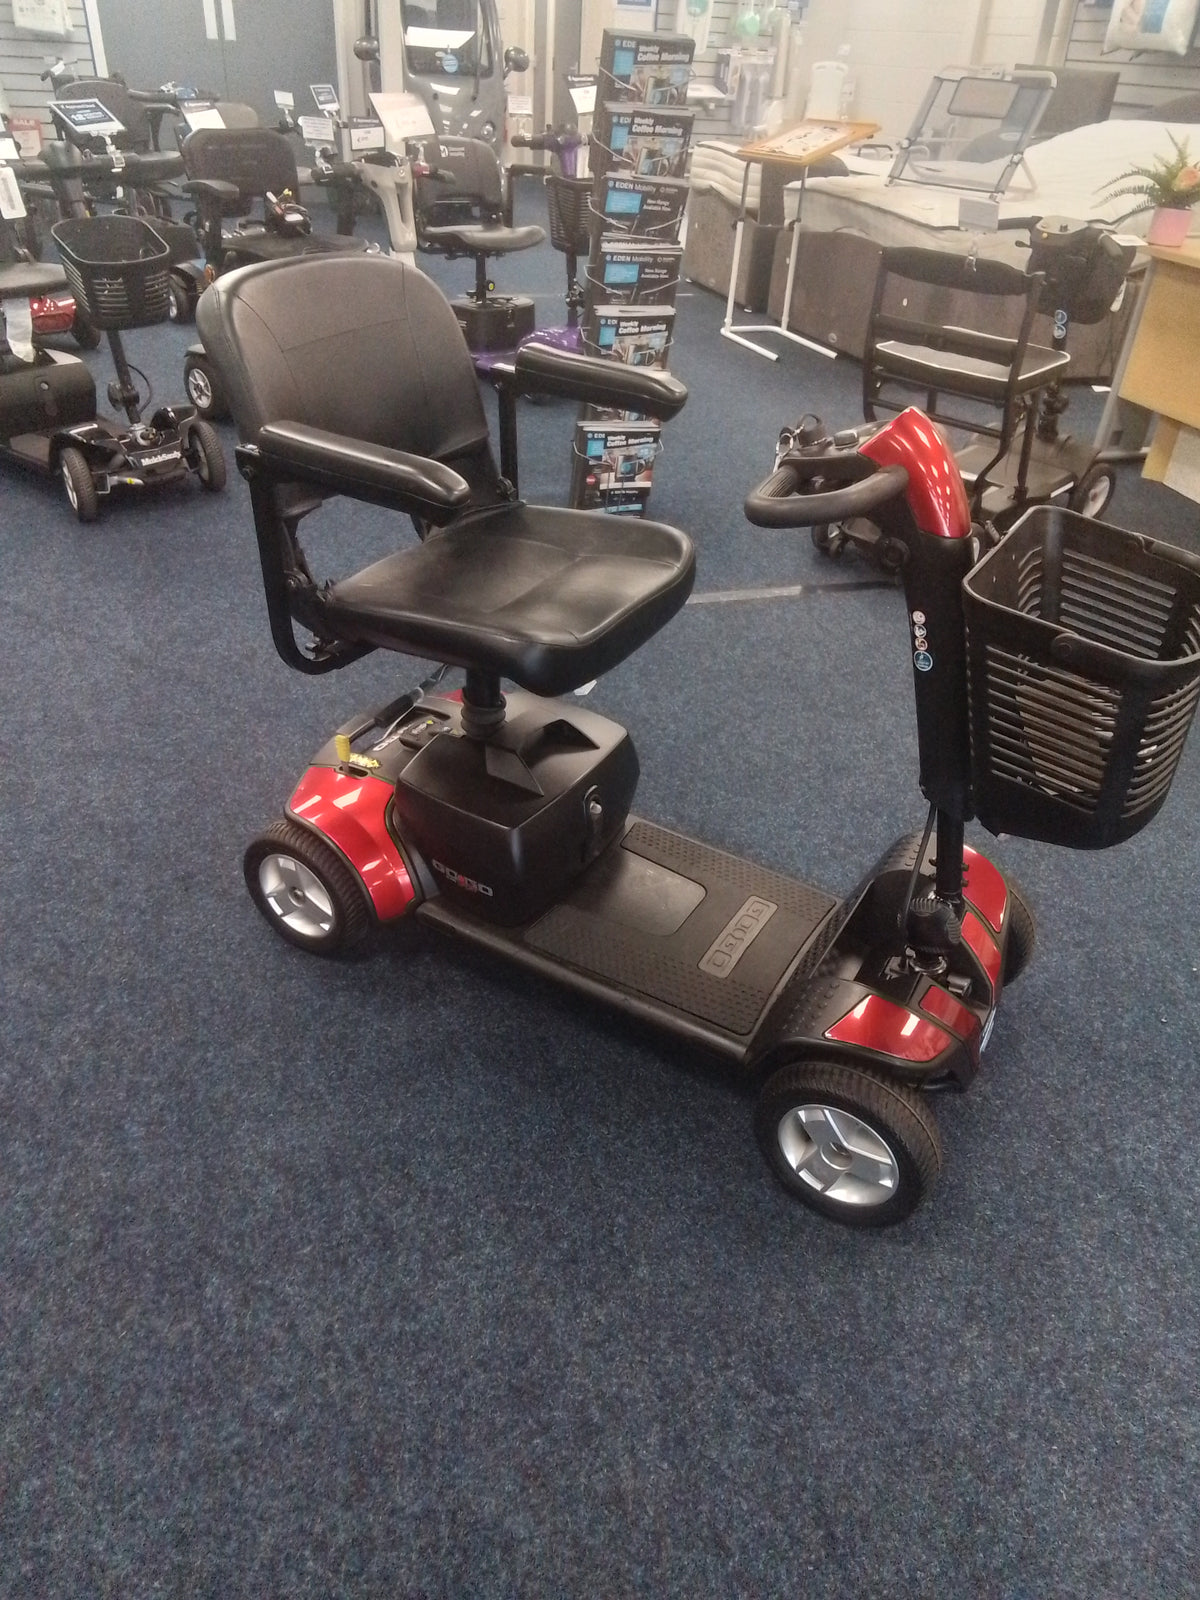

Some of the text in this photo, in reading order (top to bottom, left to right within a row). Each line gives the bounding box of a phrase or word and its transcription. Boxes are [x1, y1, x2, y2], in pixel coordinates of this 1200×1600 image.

[637, 52, 690, 63] Coffee Morning
[632, 124, 683, 136] Coffee Morning
[615, 181, 633, 190] EDEN
[634, 183, 656, 193] Mobility
[612, 254, 631, 262] EDEN
[631, 256, 654, 264] Mobility
[640, 324, 667, 333] Morning
[628, 437, 654, 445] Morning
